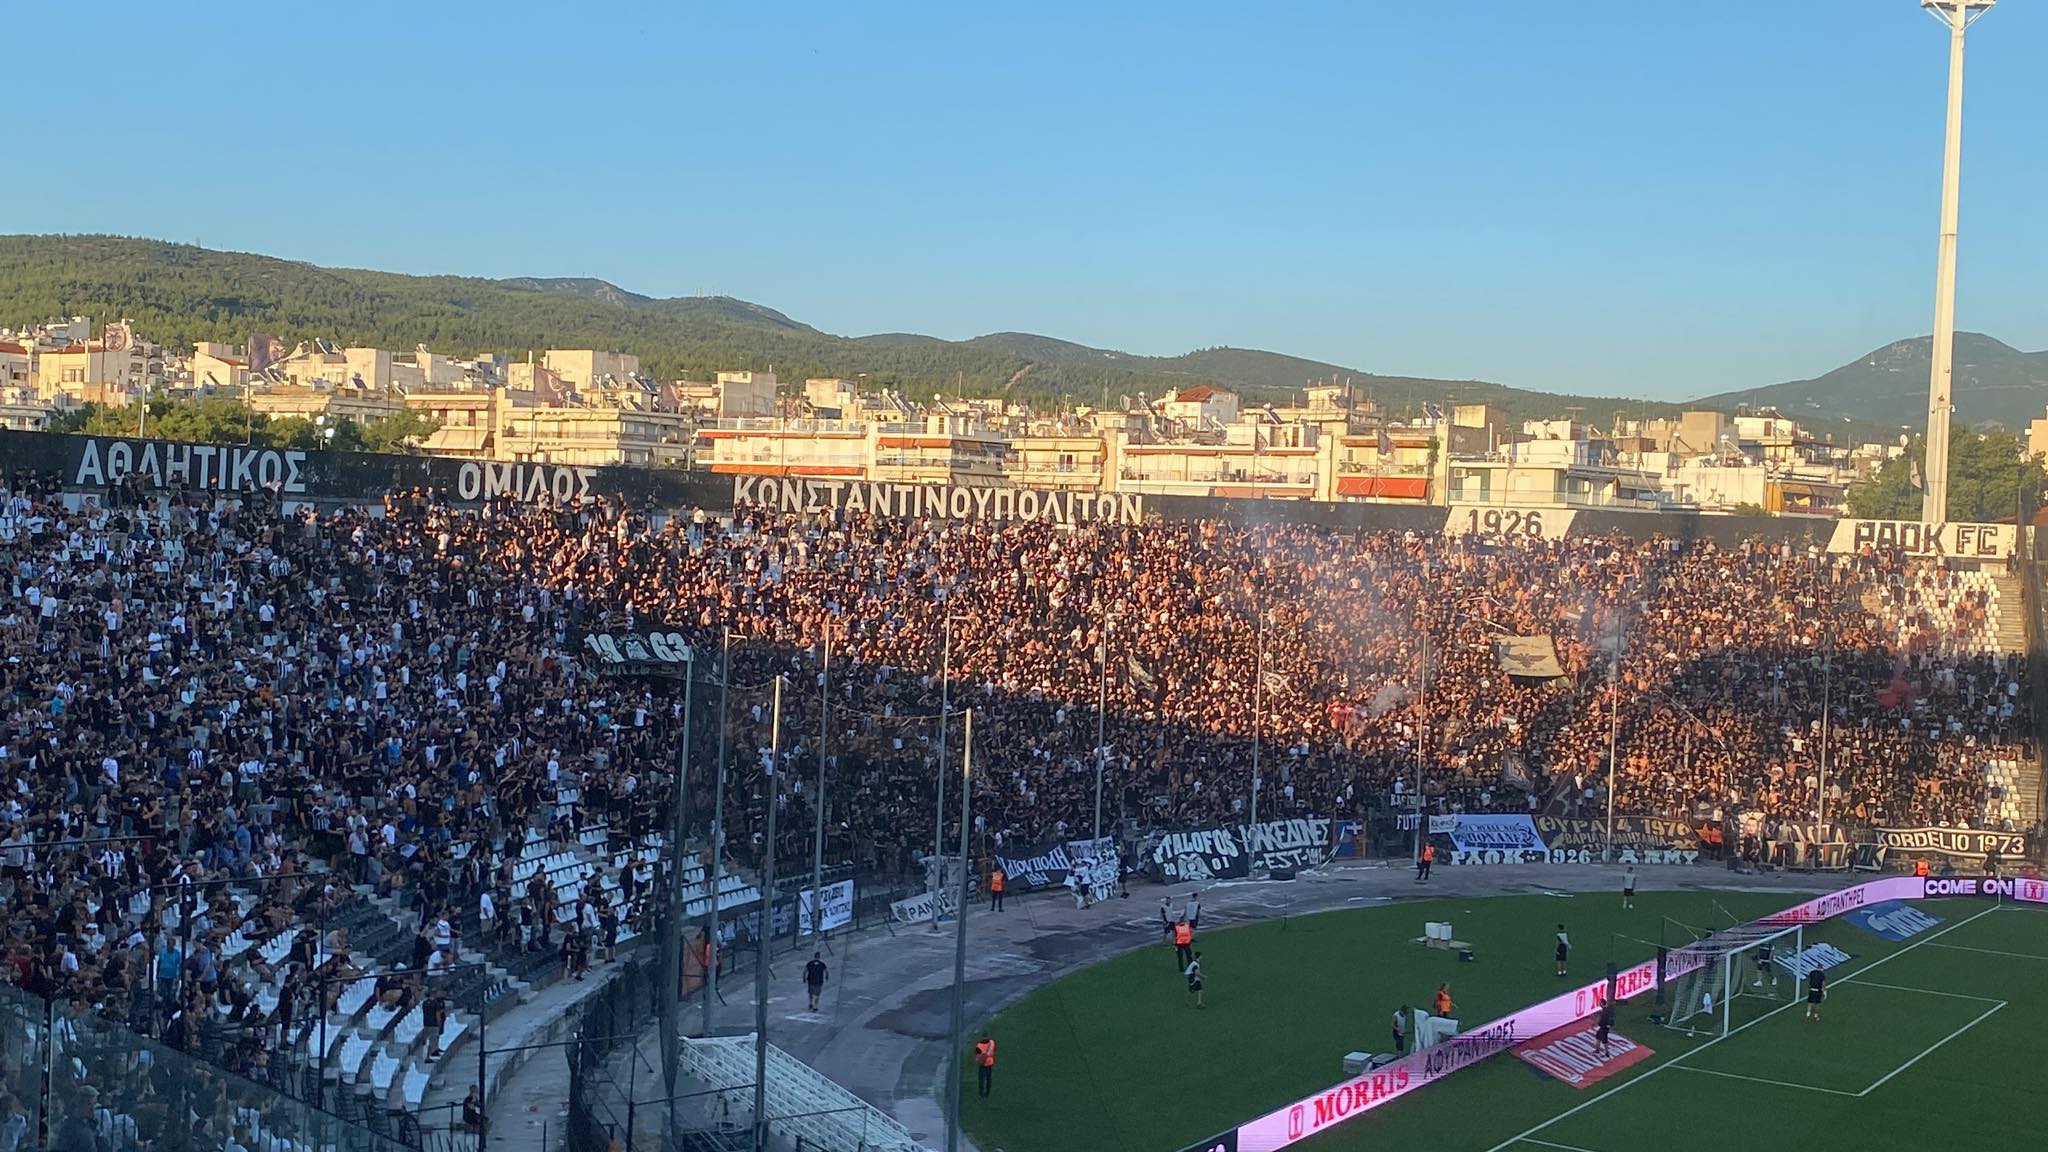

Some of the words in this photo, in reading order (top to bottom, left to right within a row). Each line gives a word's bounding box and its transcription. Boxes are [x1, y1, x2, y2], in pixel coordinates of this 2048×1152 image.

[75, 440, 306, 493] ΑΘΛΗΤΙΚΟΣ
[458, 462, 597, 504] ΟΜΙΛΟΣ
[1468, 509, 1542, 538] 1926
[1854, 522, 1946, 555] PAOK
[1956, 525, 1998, 555] FC
[649, 632, 694, 662] 63
[1617, 819, 1632, 832] 4
[1876, 831, 1970, 851] KORDELIO
[1977, 834, 2025, 853] 1973
[1543, 850, 1591, 865] 1926
[1925, 879, 1977, 895] COME
[1982, 879, 2013, 895] ON
[1591, 965, 1653, 1010] MRRIS
[1314, 1067, 1409, 1128] MORRIS
